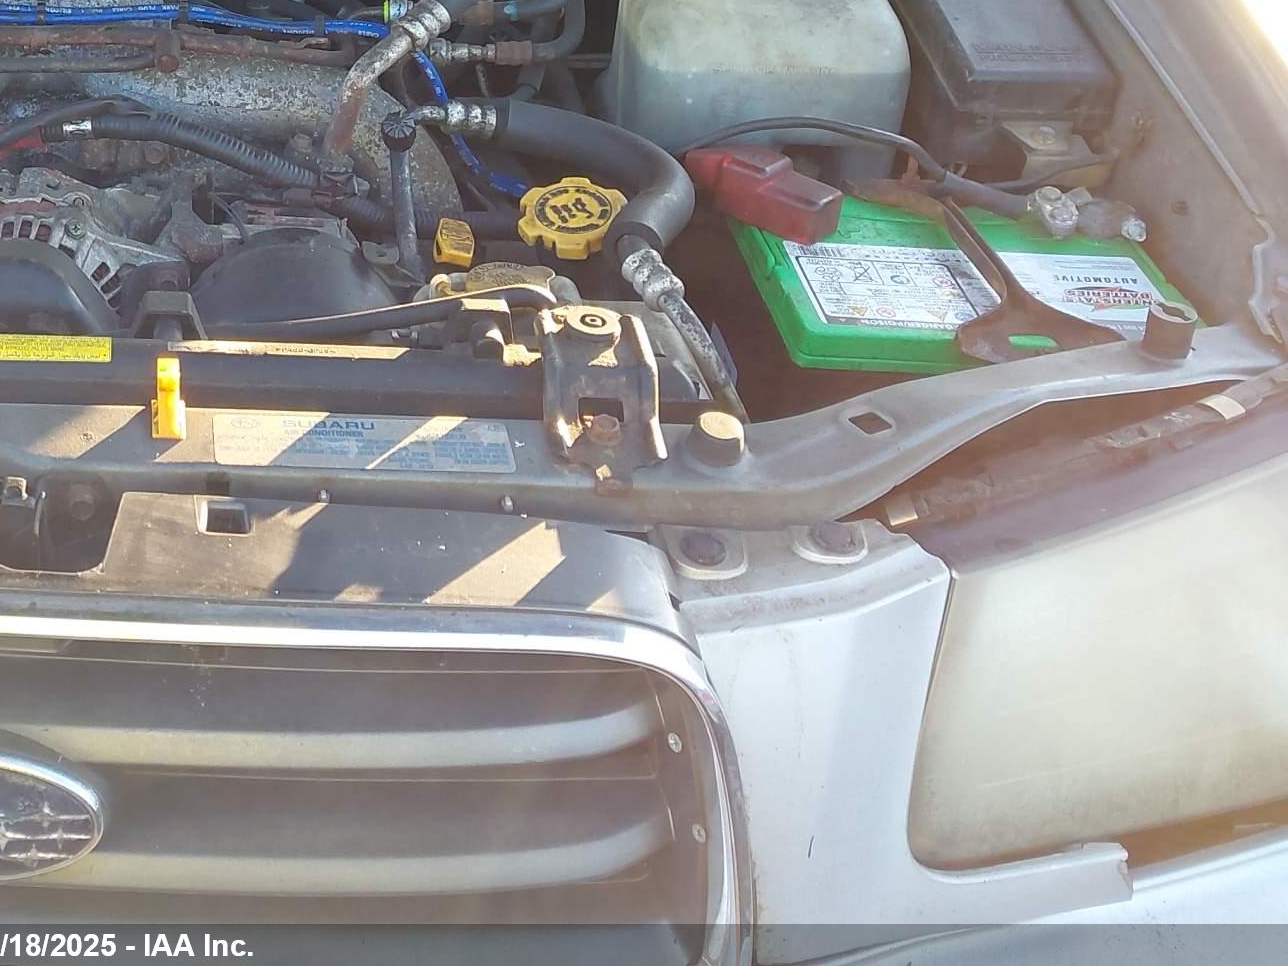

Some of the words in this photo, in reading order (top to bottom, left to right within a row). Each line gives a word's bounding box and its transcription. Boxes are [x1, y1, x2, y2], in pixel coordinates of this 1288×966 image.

[1053, 274, 1138, 285] AUTOMOTIVE
[1065, 289, 1151, 300] BATTERIES
[283, 419, 375, 431] SUBARU
